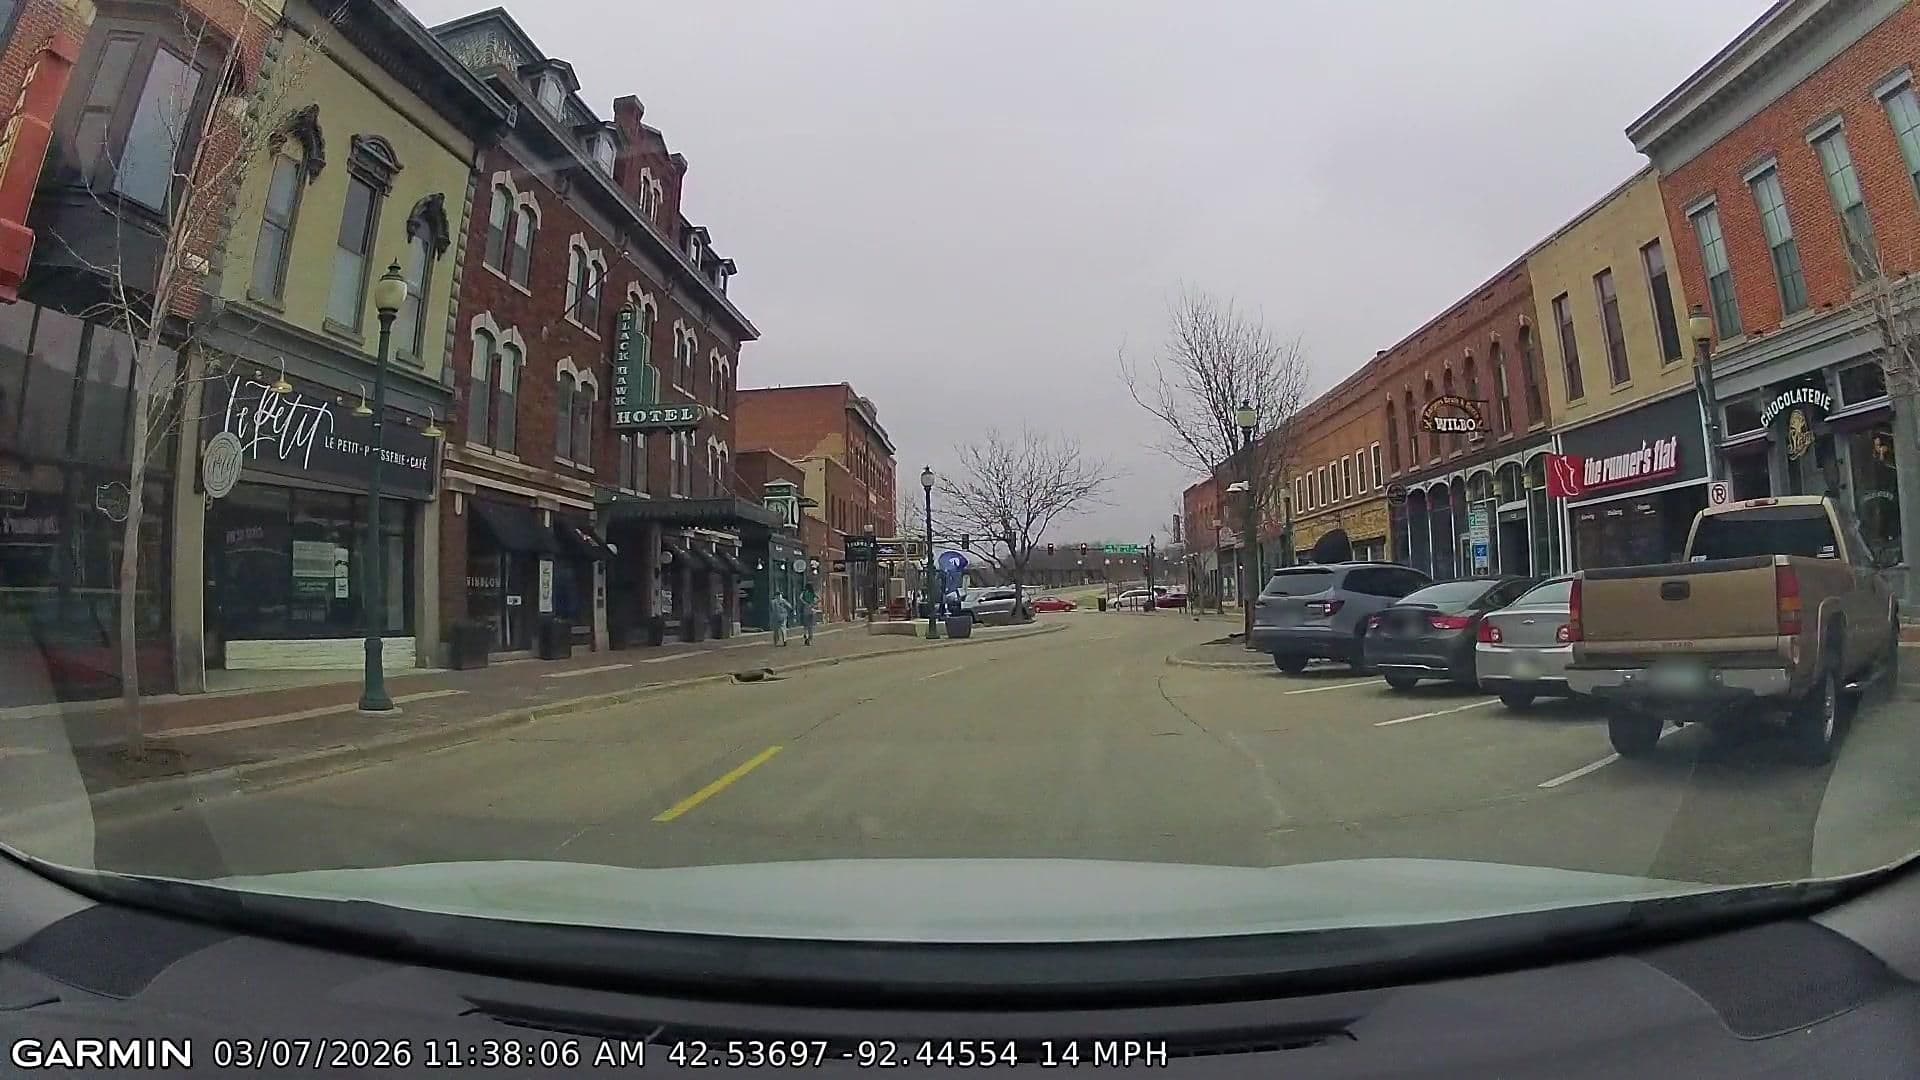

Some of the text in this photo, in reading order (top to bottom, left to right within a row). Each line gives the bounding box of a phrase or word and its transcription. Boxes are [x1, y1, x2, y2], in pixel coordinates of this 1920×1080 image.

[619, 312, 632, 361] BLACK
[614, 366, 628, 406] HAWK
[245, 381, 334, 470] Petit
[616, 408, 694, 424] HOTEL
[1434, 417, 1476, 431] WILBO
[1760, 387, 1832, 428] CHOCOLATERIE
[324, 435, 335, 449] LE
[337, 438, 360, 454] PETIT
[1583, 435, 1678, 486] the runner's flat
